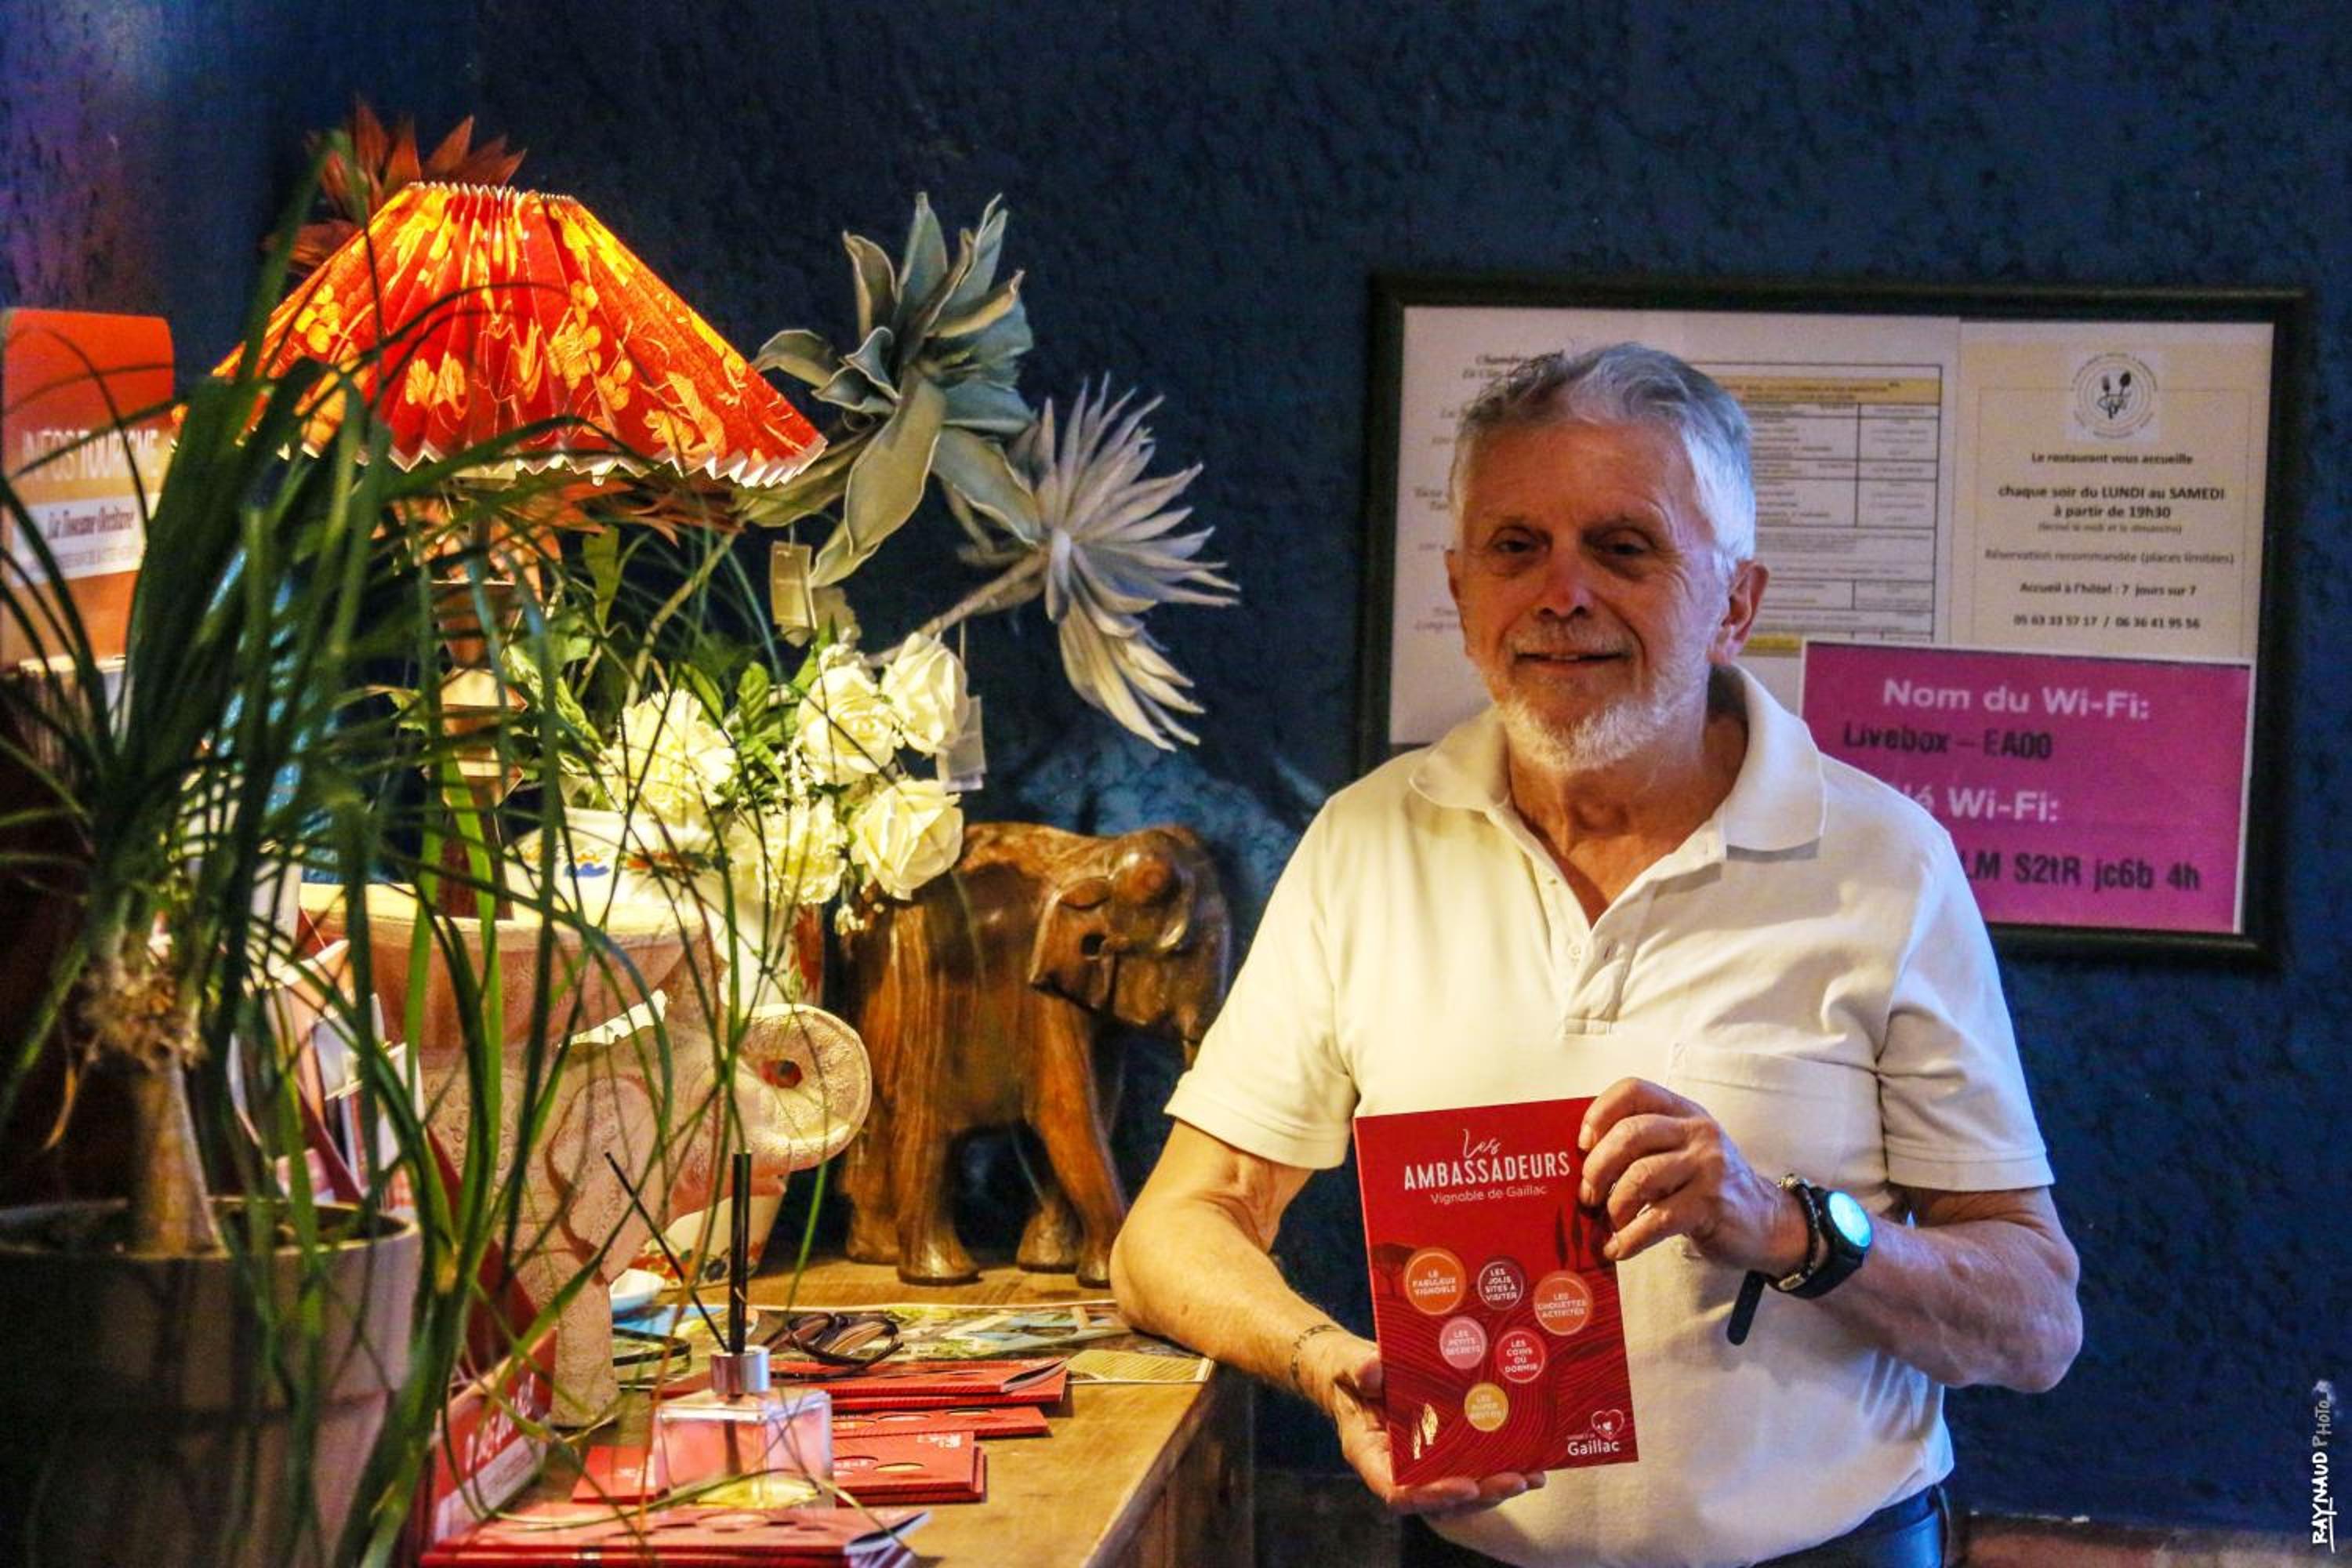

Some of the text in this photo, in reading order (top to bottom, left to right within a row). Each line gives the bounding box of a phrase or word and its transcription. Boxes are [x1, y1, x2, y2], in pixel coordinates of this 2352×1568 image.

[2031, 452, 2193, 466] Le restaurant vous accueille
[1998, 485, 2225, 501] chaque soir du LUNDI au SAMEDI
[2065, 506, 2102, 521] partir
[2107, 506, 2124, 517] de
[2129, 506, 2171, 519] 19h30
[1883, 680, 2149, 720] Nom du Wi-Fi:
[1843, 721, 1949, 753] Livebox
[1947, 787, 2059, 822] Wi-Fi:
[2013, 852, 2082, 885] S2tR
[1462, 1128, 1501, 1159] Les
[1404, 1152, 1570, 1190] AMBASSADEURS
[1430, 1185, 1548, 1205] Vignoble de Gaillac
[1490, 1268, 1504, 1276] LES
[1486, 1292, 1517, 1301] VISITER
[1512, 1339, 1526, 1348] LES
[1568, 1439, 1620, 1456] Gaillac
